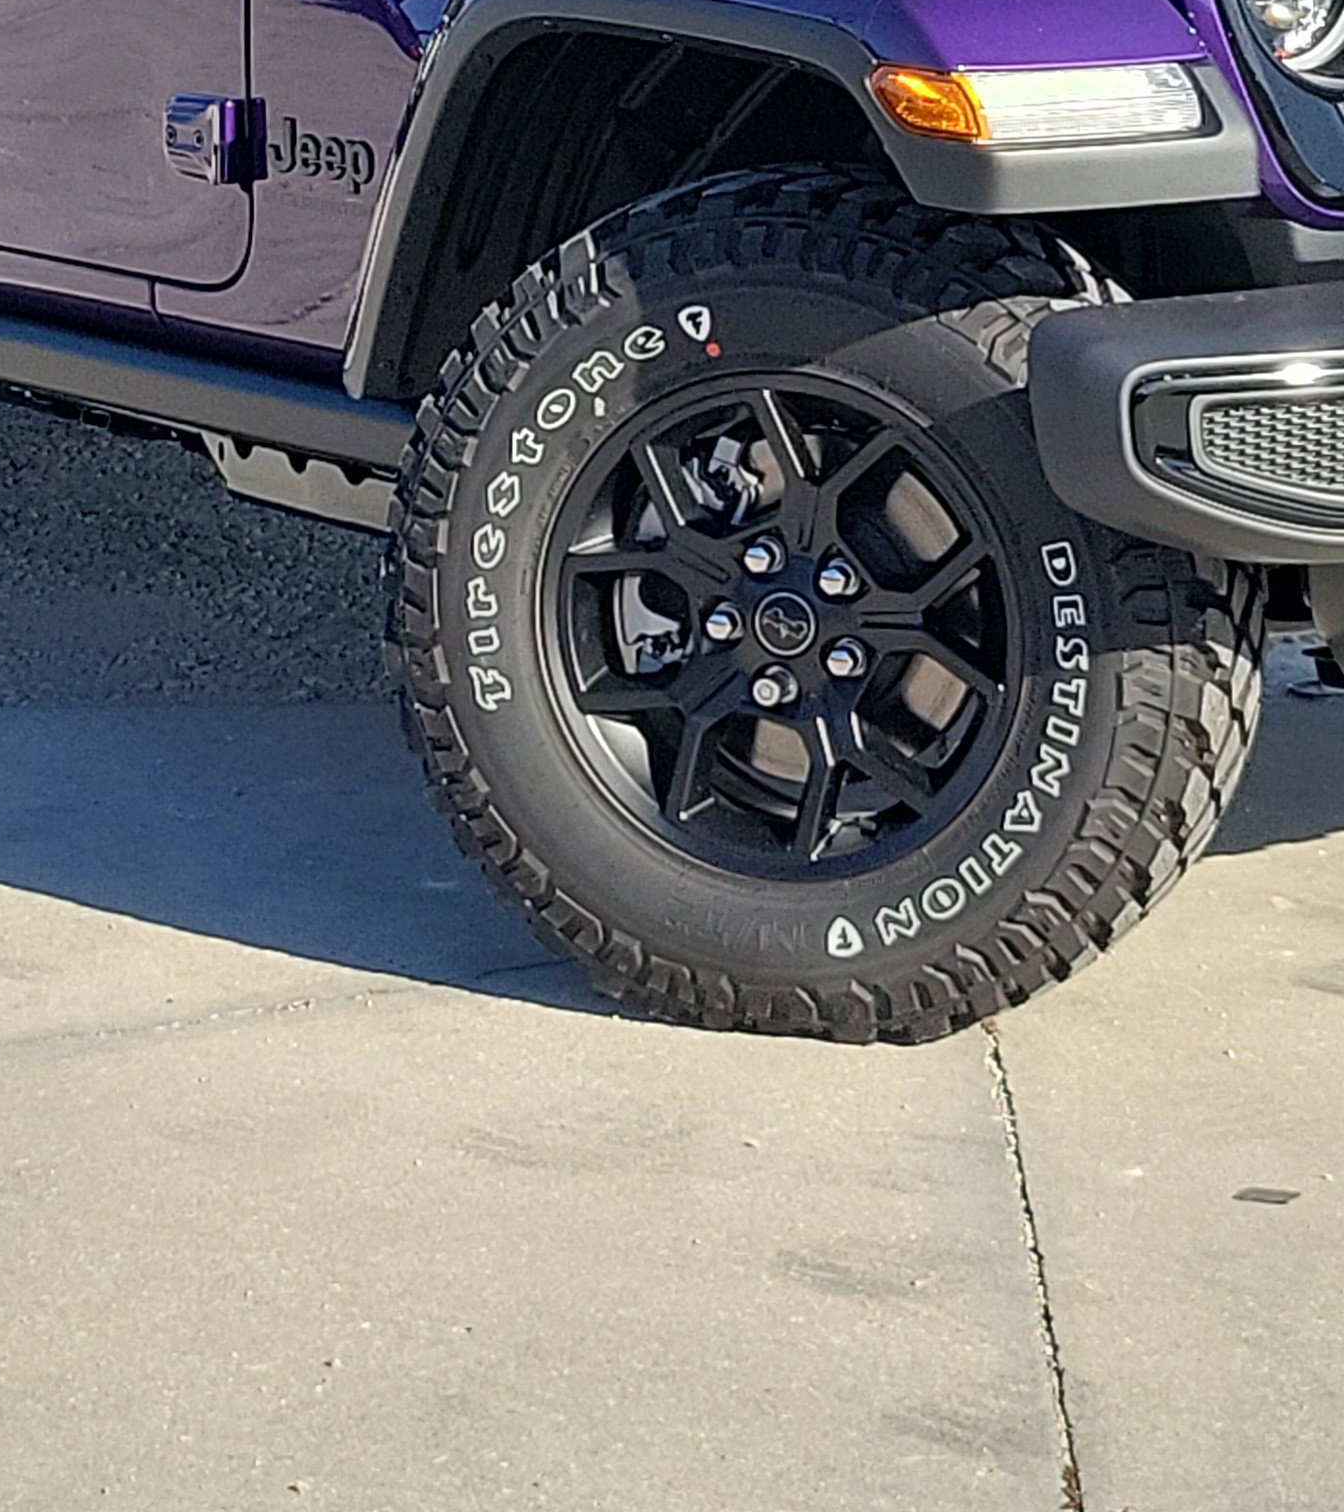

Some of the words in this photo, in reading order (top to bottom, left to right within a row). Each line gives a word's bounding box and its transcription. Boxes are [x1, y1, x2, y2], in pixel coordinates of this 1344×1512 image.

[267, 116, 375, 195] Jeep
[467, 325, 666, 711] Firestone
[874, 541, 1090, 946] DESTINATION
